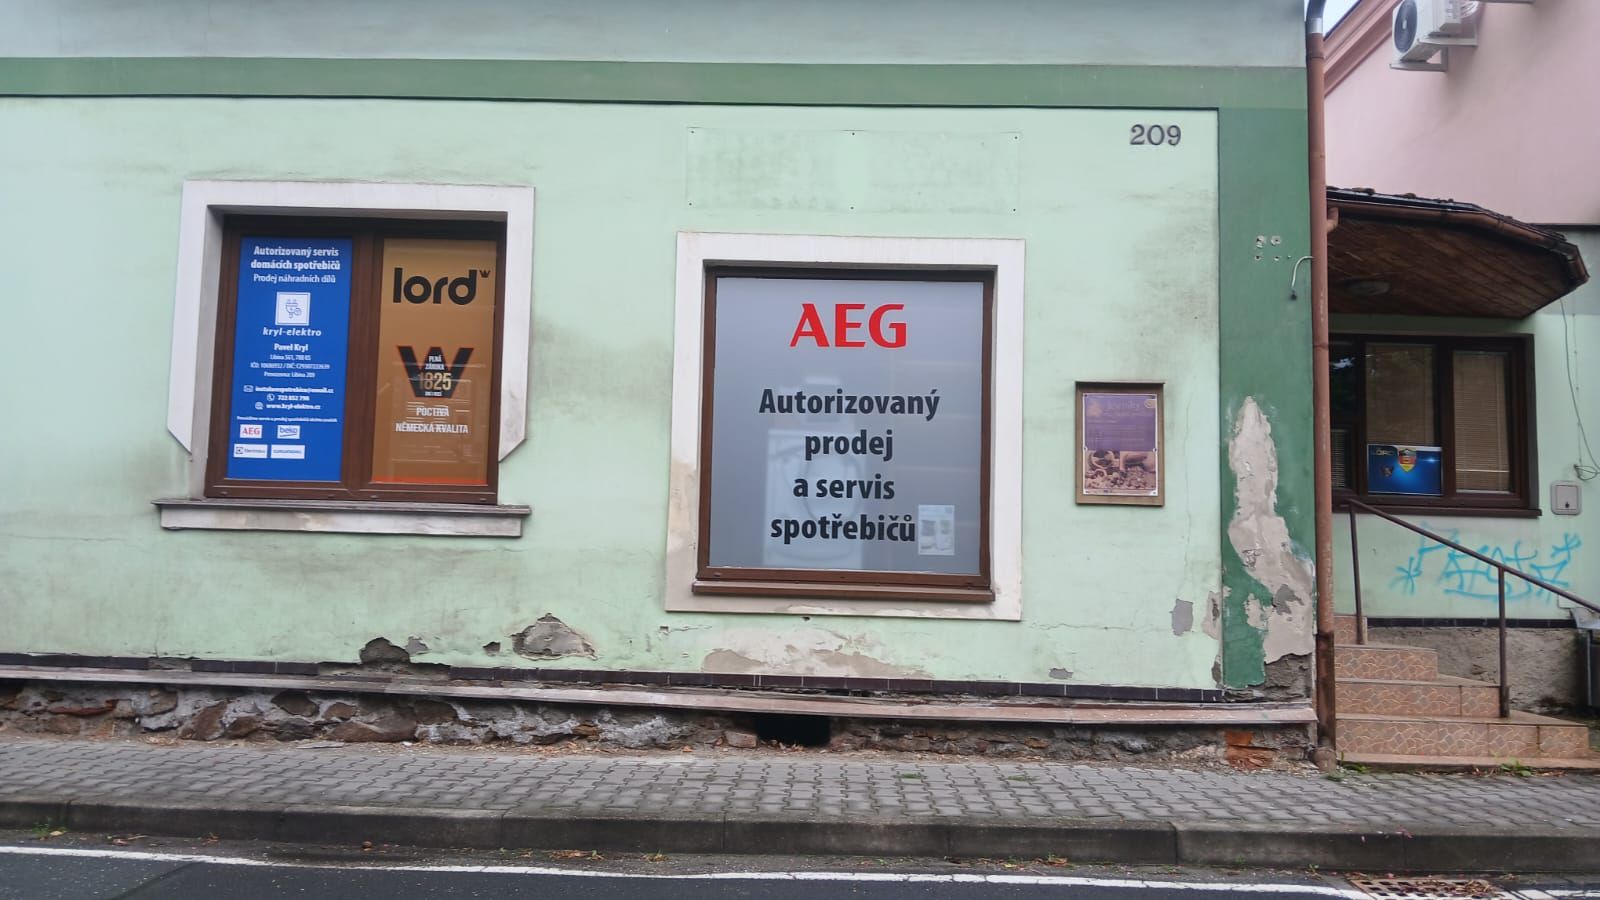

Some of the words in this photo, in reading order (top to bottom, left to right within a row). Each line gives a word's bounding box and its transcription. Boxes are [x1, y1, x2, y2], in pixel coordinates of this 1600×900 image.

[1129, 124, 1182, 146] 209
[253, 246, 312, 258] Autorizovaný
[312, 248, 339, 257] servis
[250, 259, 292, 269] domácích
[293, 260, 340, 271] spotřebičů
[253, 273, 277, 284] Prodej
[278, 274, 320, 283] náhradních
[321, 275, 336, 283] dílů
[393, 267, 477, 305] lord
[262, 327, 322, 337] kryl-elektro
[790, 303, 907, 348] AEG
[273, 343, 293, 351] Pavel
[293, 343, 309, 352] Kryl
[419, 372, 452, 391] 1825
[759, 388, 941, 422] Autorizovaný
[242, 427, 261, 435] AEG
[804, 429, 893, 462] prodej
[793, 478, 809, 498] a
[815, 473, 895, 500] servis
[770, 513, 916, 545] spotřebičů
